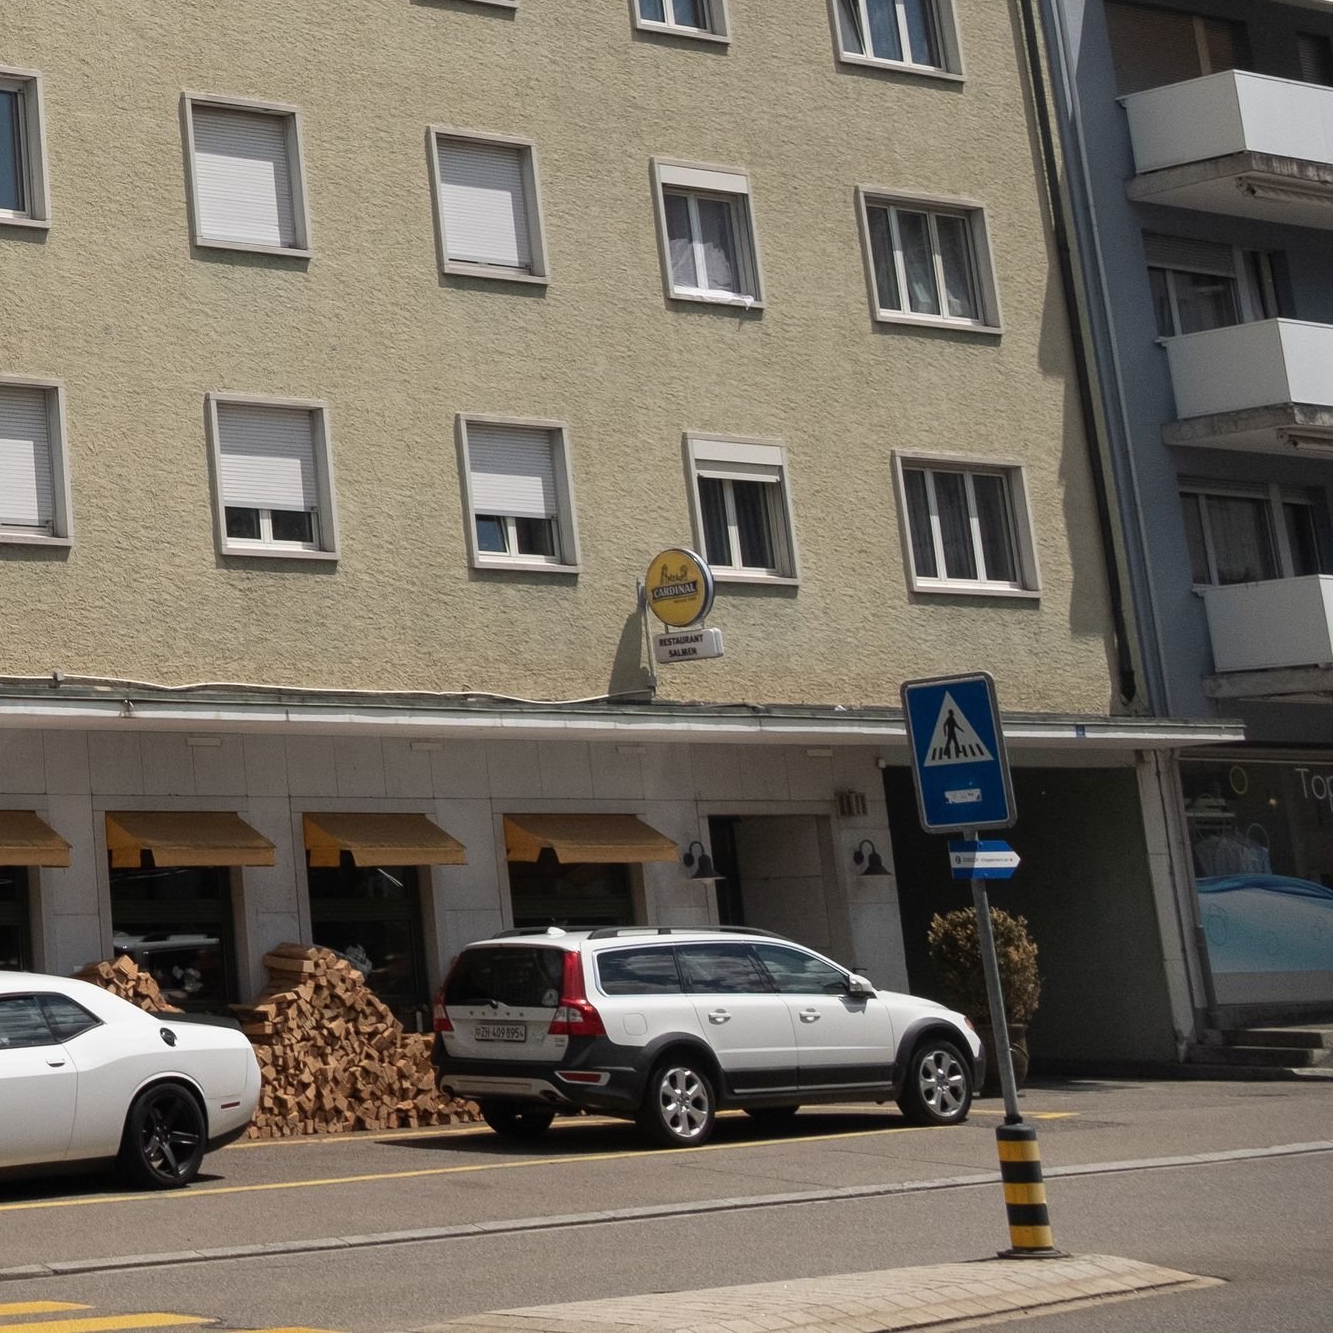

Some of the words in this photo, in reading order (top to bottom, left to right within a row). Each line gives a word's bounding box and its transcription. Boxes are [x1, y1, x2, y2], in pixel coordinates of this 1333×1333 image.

[654, 583, 696, 599] CARDINAL
[659, 634, 703, 646] RESTAURANT
[669, 647, 698, 658] SALMEN
